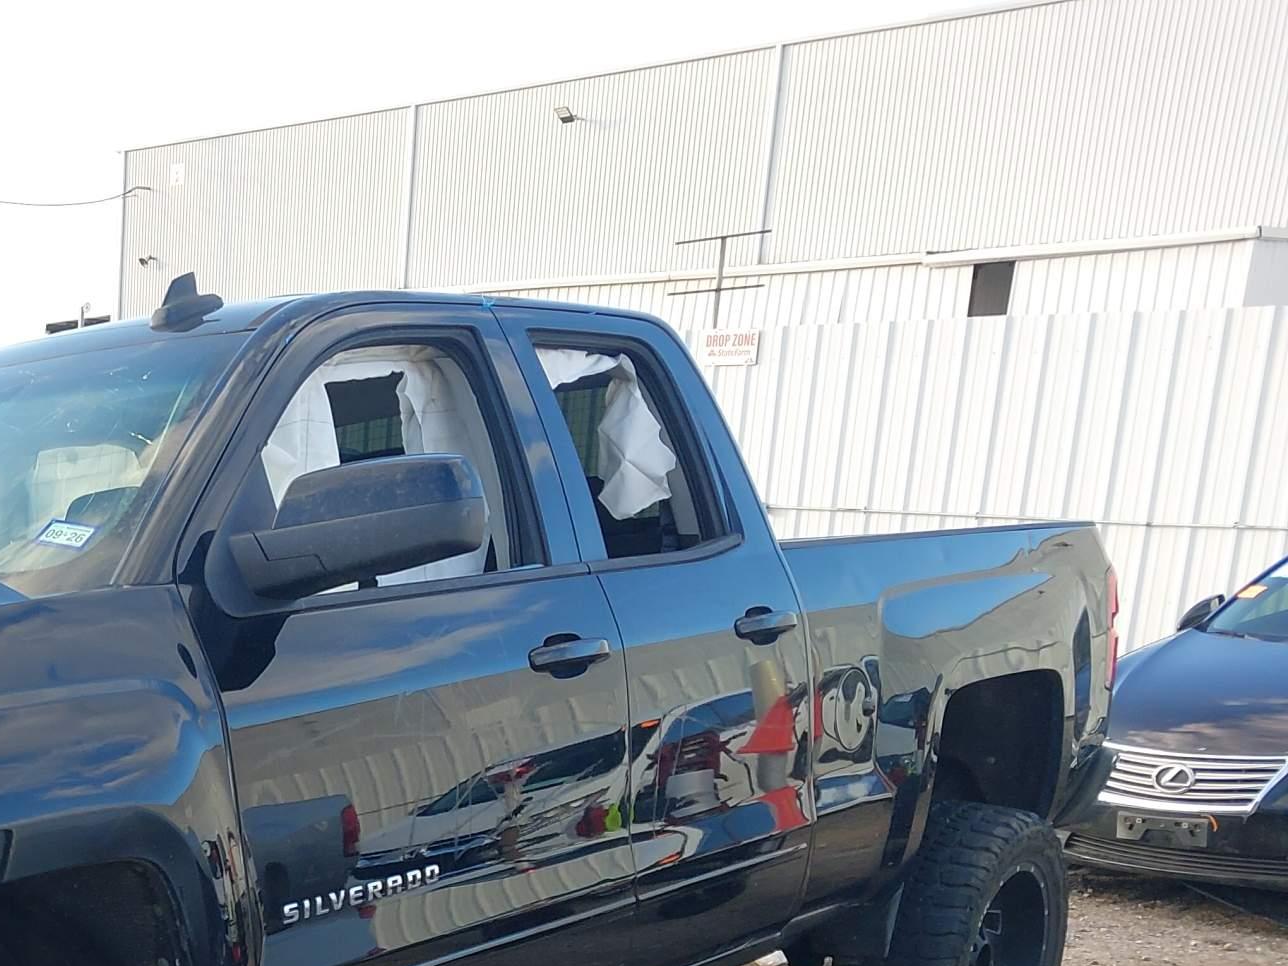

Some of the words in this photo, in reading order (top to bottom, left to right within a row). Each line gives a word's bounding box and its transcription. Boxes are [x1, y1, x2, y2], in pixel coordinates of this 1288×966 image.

[706, 334, 730, 347] DROP
[732, 332, 756, 346] ZONE
[282, 863, 441, 925] SILVERADO
